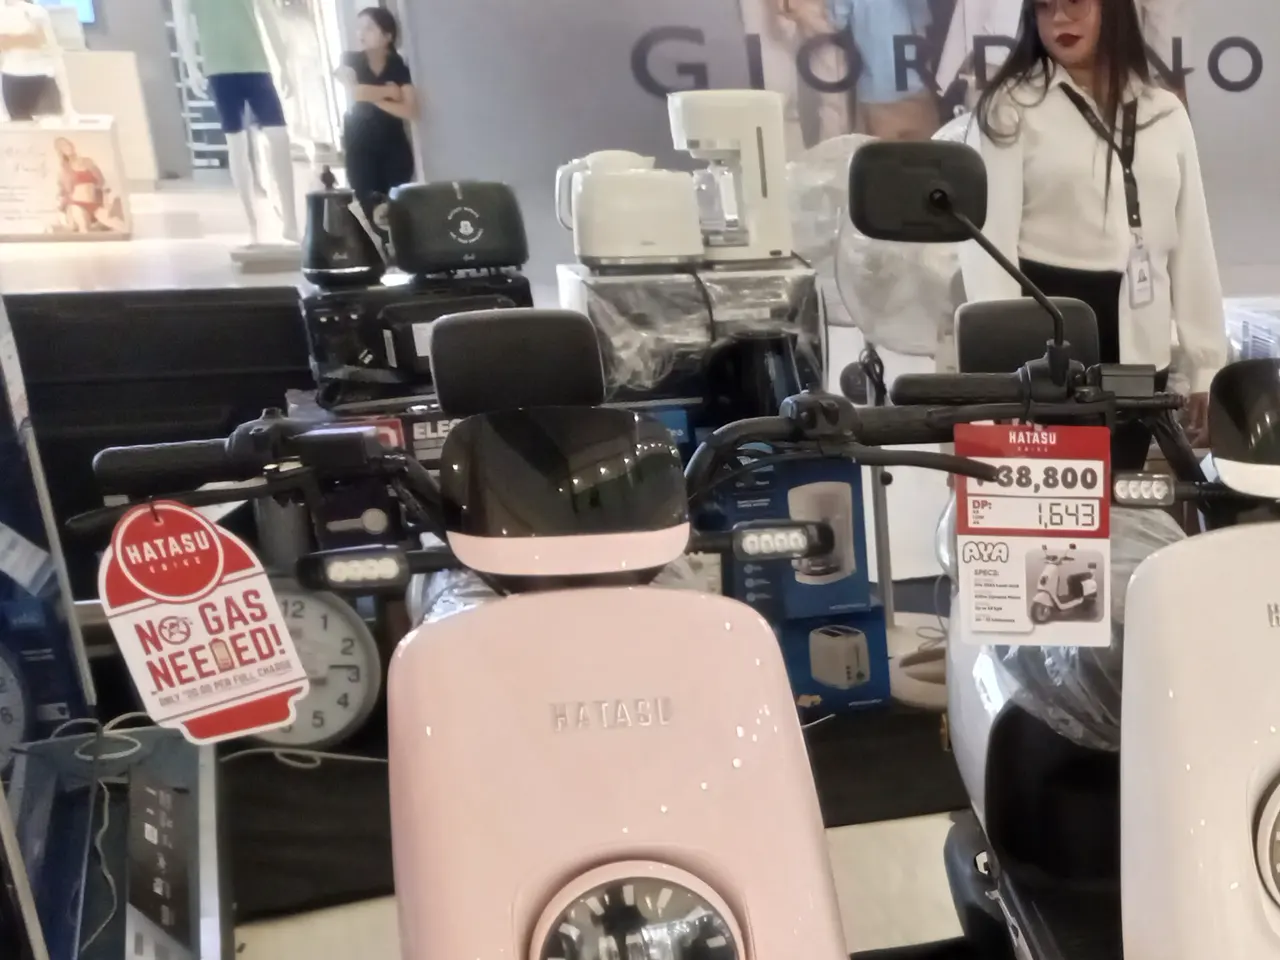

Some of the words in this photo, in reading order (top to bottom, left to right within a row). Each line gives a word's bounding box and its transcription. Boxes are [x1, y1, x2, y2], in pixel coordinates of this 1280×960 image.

[631, 26, 1264, 99] GIORDNO
[1008, 431, 1057, 445] HATASU
[972, 499, 992, 510] DP:
[1038, 503, 1095, 529] 1,643
[124, 530, 210, 565] HATASU
[962, 541, 1009, 563] AYA
[198, 588, 268, 636] GAS
[549, 697, 672, 733] HATASU
